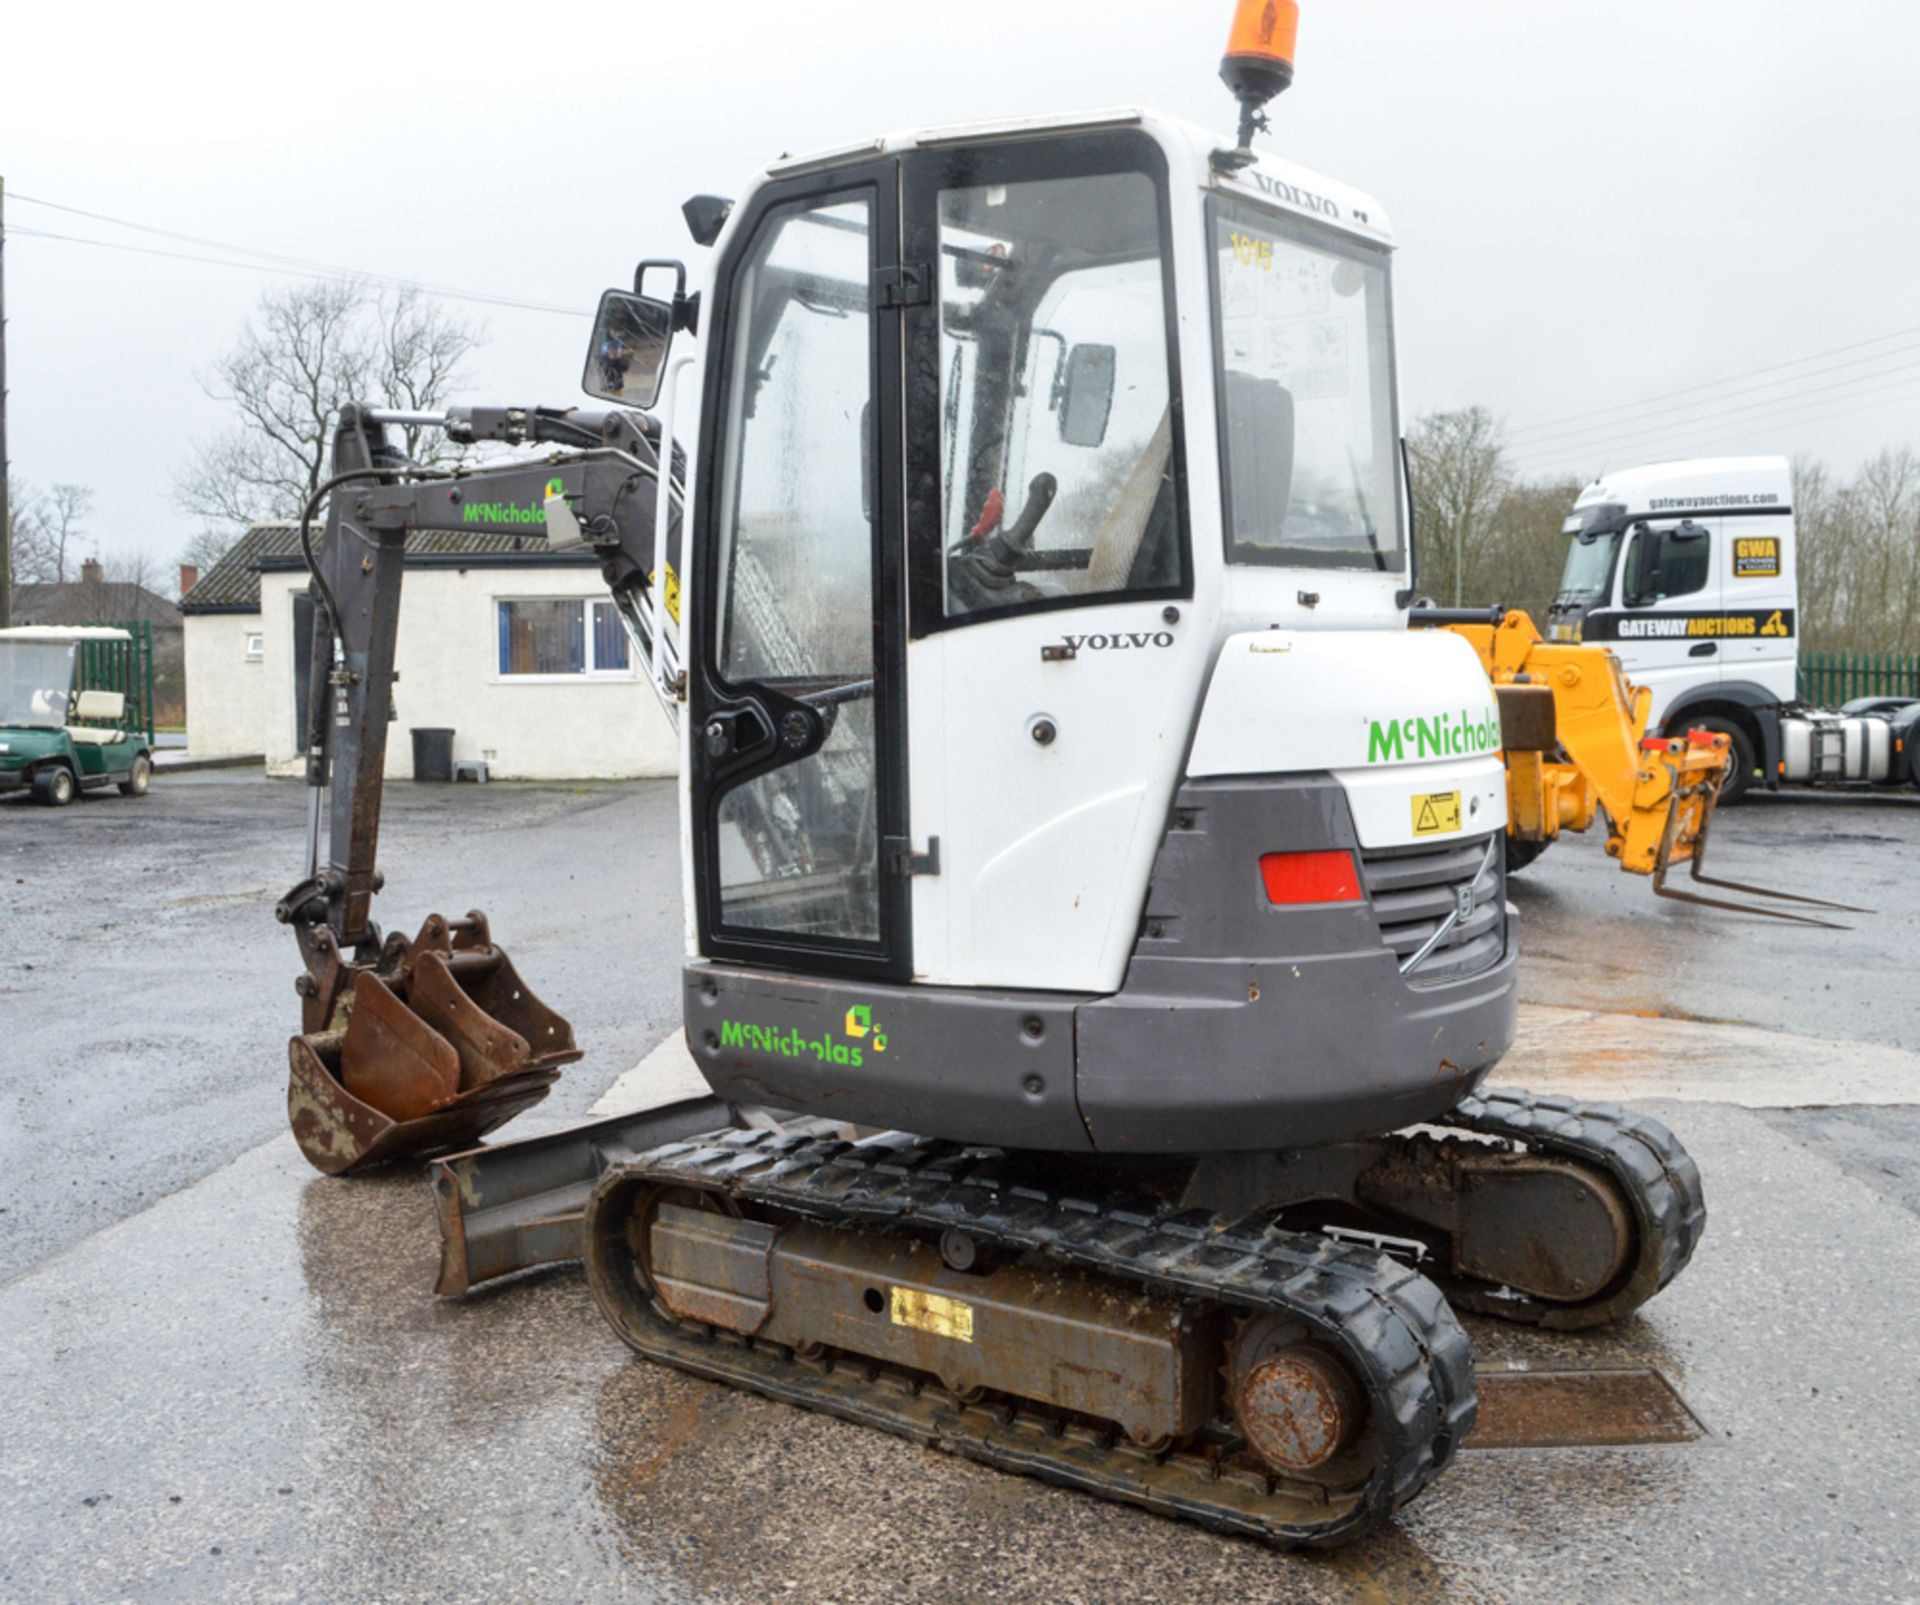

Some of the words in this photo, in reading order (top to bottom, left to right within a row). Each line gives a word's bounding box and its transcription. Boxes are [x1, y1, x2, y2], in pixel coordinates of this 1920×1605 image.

[1230, 231, 1273, 271] 1015
[1649, 493, 1778, 509] gatewayauctions.com
[463, 501, 547, 524] McNichola
[1737, 540, 1776, 557] GWA
[1061, 631, 1174, 650] VOLVO
[1368, 707, 1500, 763] McNichola
